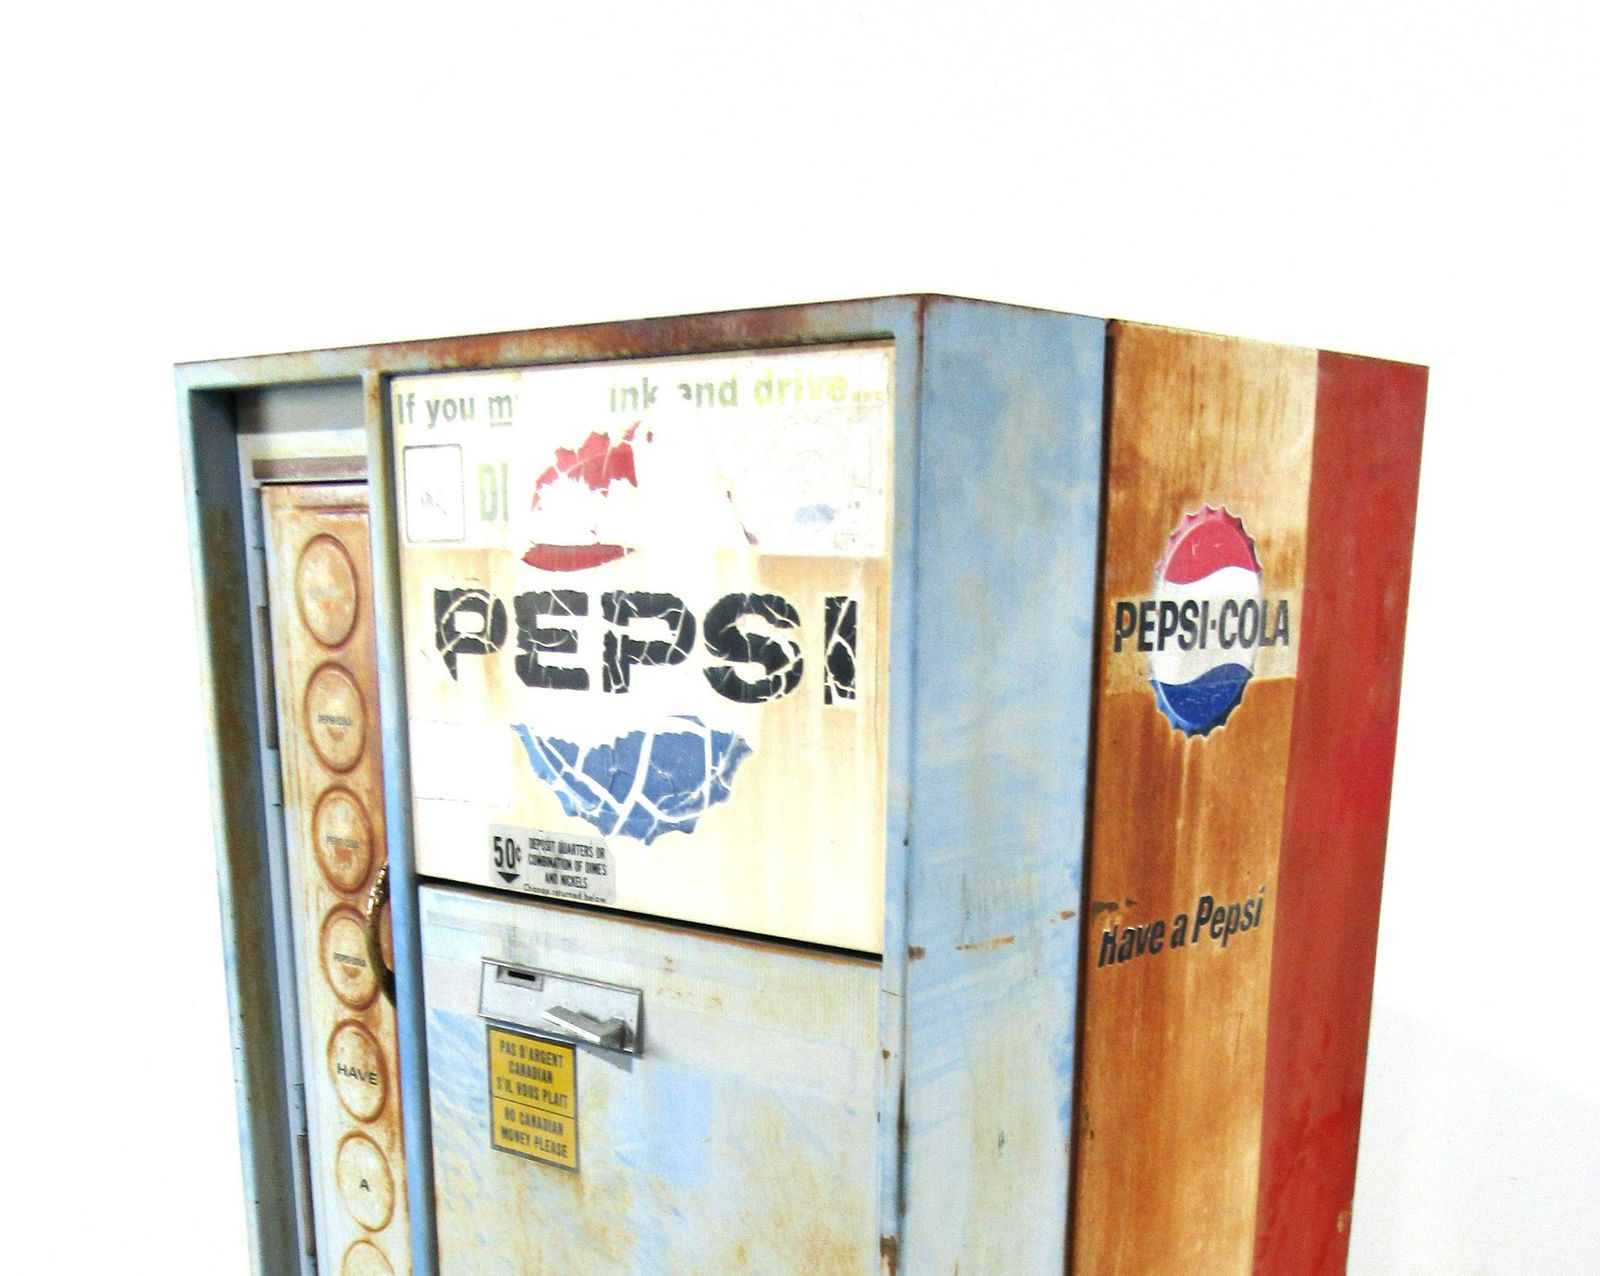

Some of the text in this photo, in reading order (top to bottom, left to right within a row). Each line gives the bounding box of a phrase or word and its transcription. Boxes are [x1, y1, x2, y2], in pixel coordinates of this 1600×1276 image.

[397, 392, 415, 424] If
[426, 397, 475, 428] you
[434, 588, 857, 705] PEPSI
[558, 842, 593, 858] QUARTERS
[585, 861, 607, 875] DIMES
[561, 875, 587, 889] NICKELS
[1098, 885, 1266, 968] Have a Pepsi
[500, 1040, 516, 1056] PAS
[337, 1062, 378, 1086] HAVE
[509, 1060, 553, 1084] CANADIAN
[517, 1082, 540, 1101] VOUS
[504, 1106, 563, 1136] NO CANADIAN
[501, 1126, 568, 1158] MONEY PLEASE
[359, 1178, 371, 1192] A
